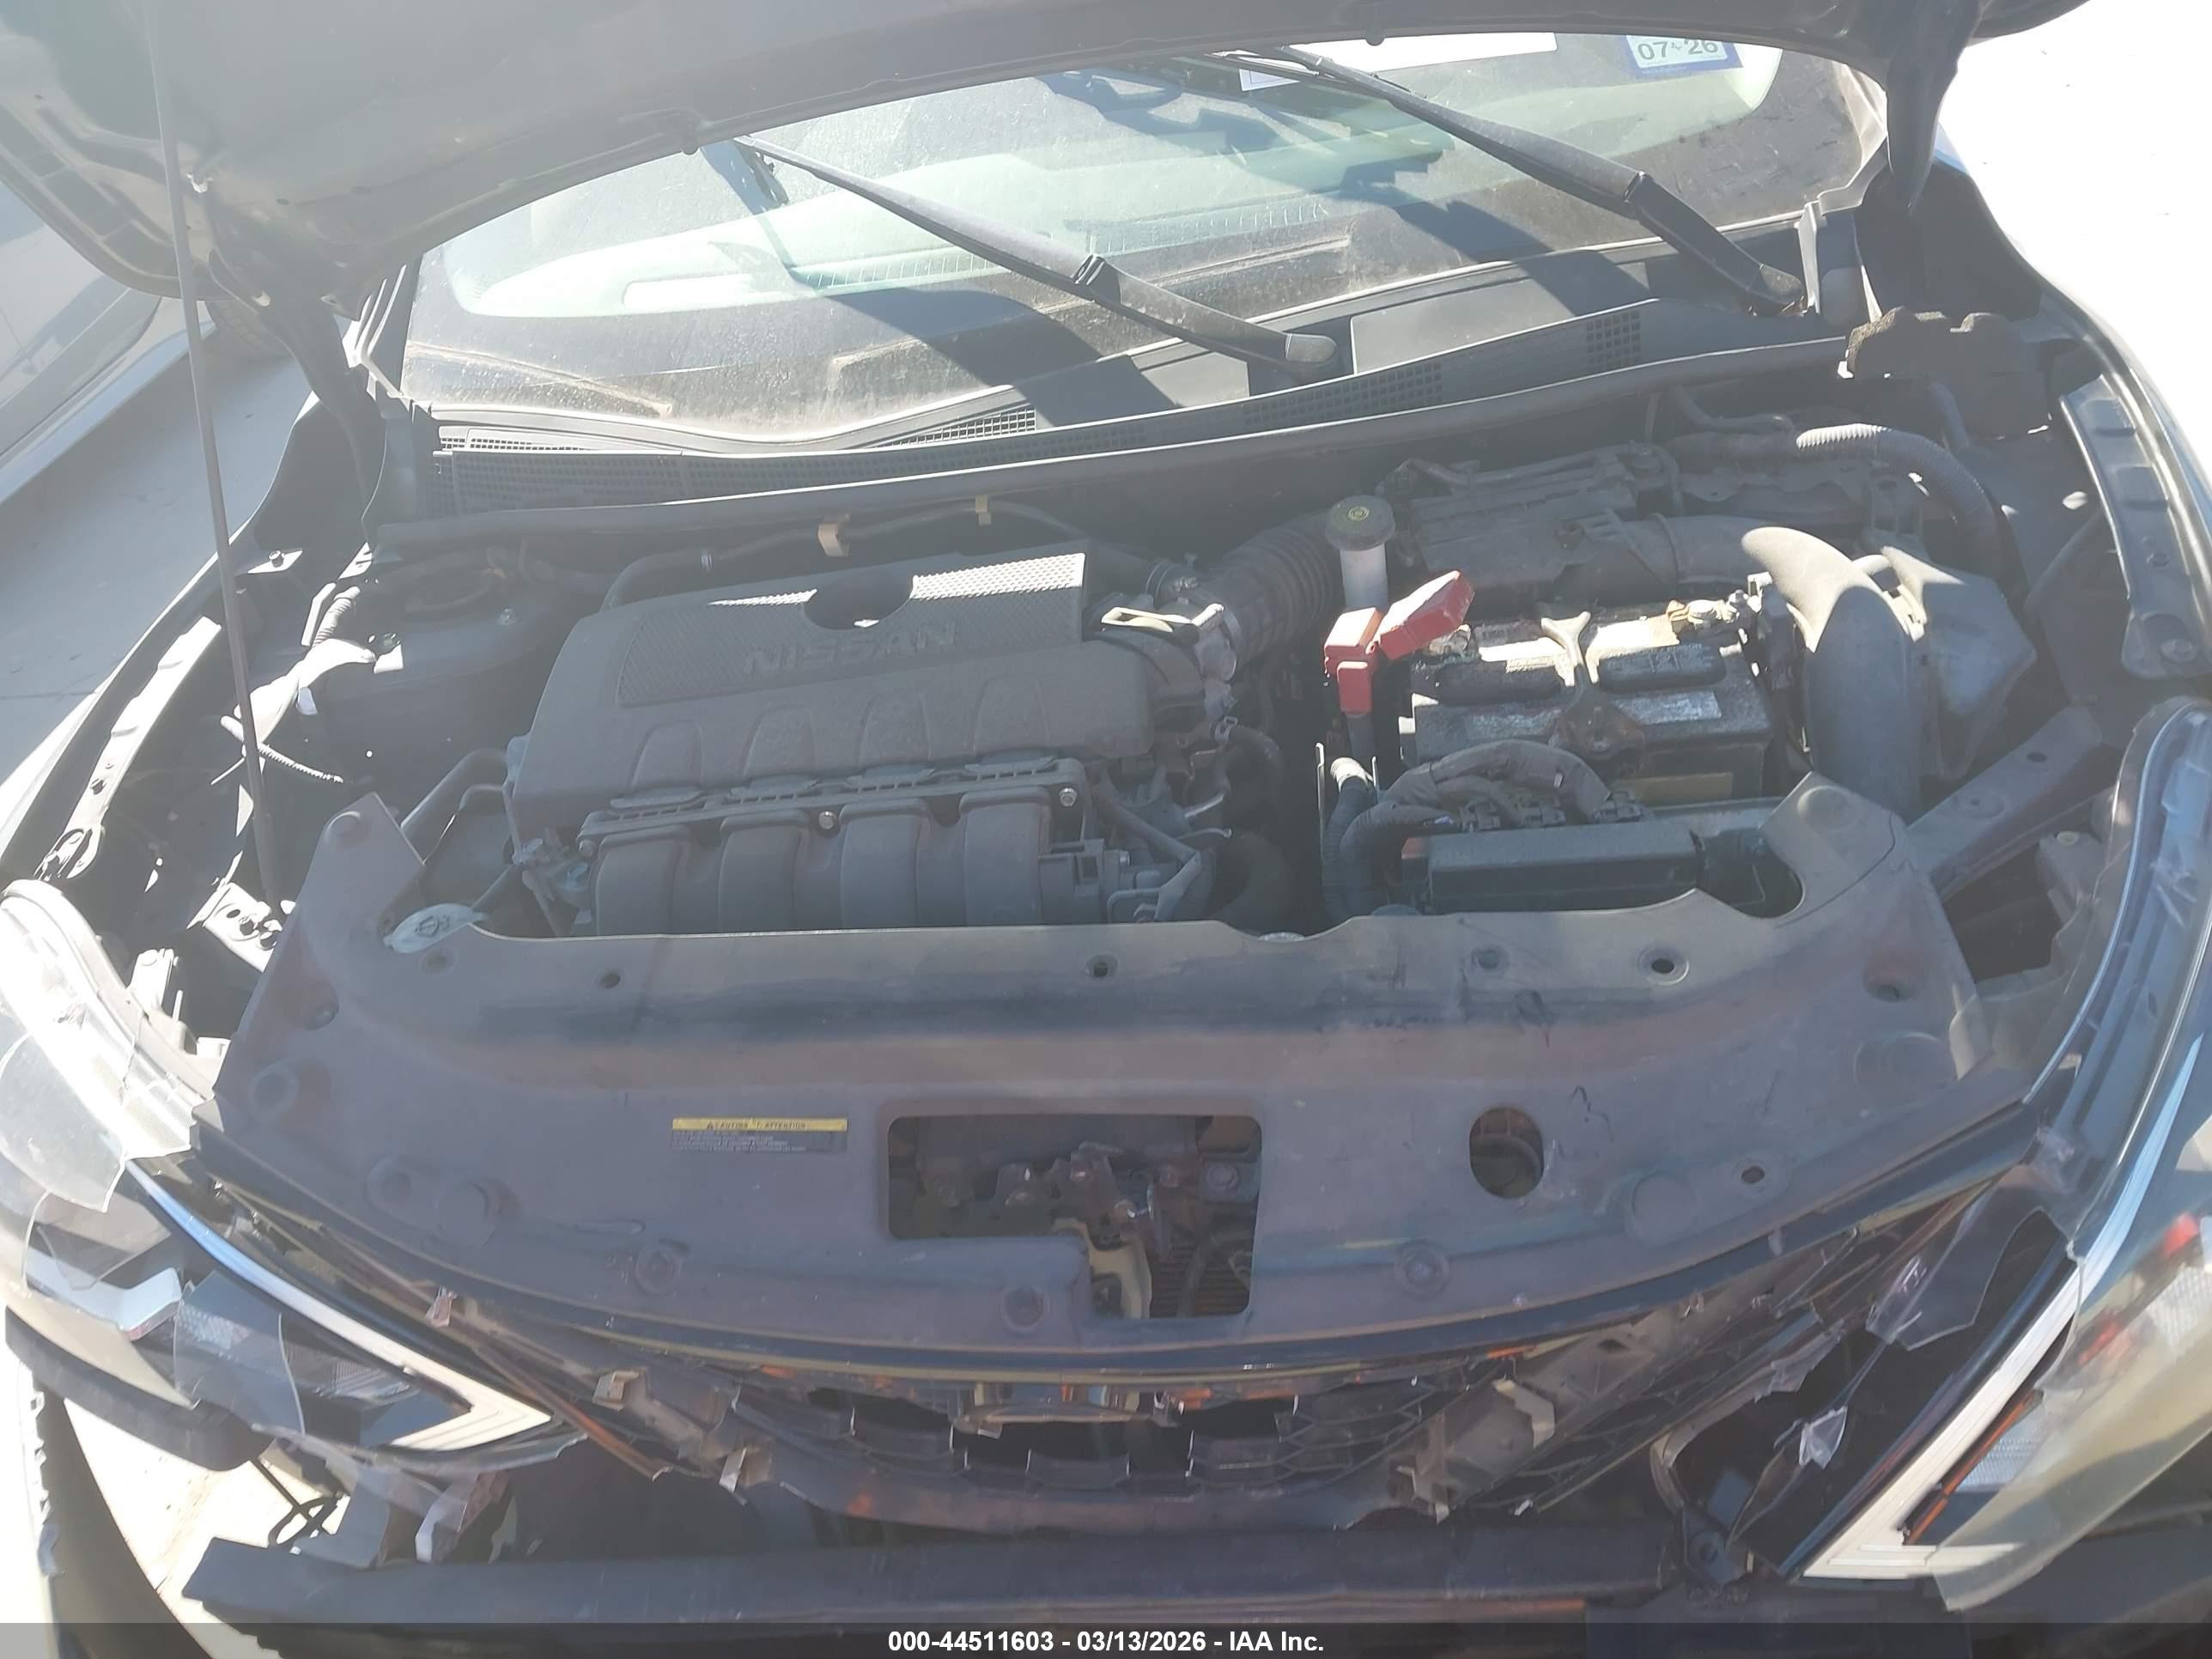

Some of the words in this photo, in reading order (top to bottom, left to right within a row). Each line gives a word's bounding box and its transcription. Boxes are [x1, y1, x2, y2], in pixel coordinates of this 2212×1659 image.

[1638, 40, 1668, 60] 07
[741, 620, 956, 673] NISSAN
[714, 1121, 749, 1129] CAUTION
[764, 1121, 807, 1129] ATTENTION
